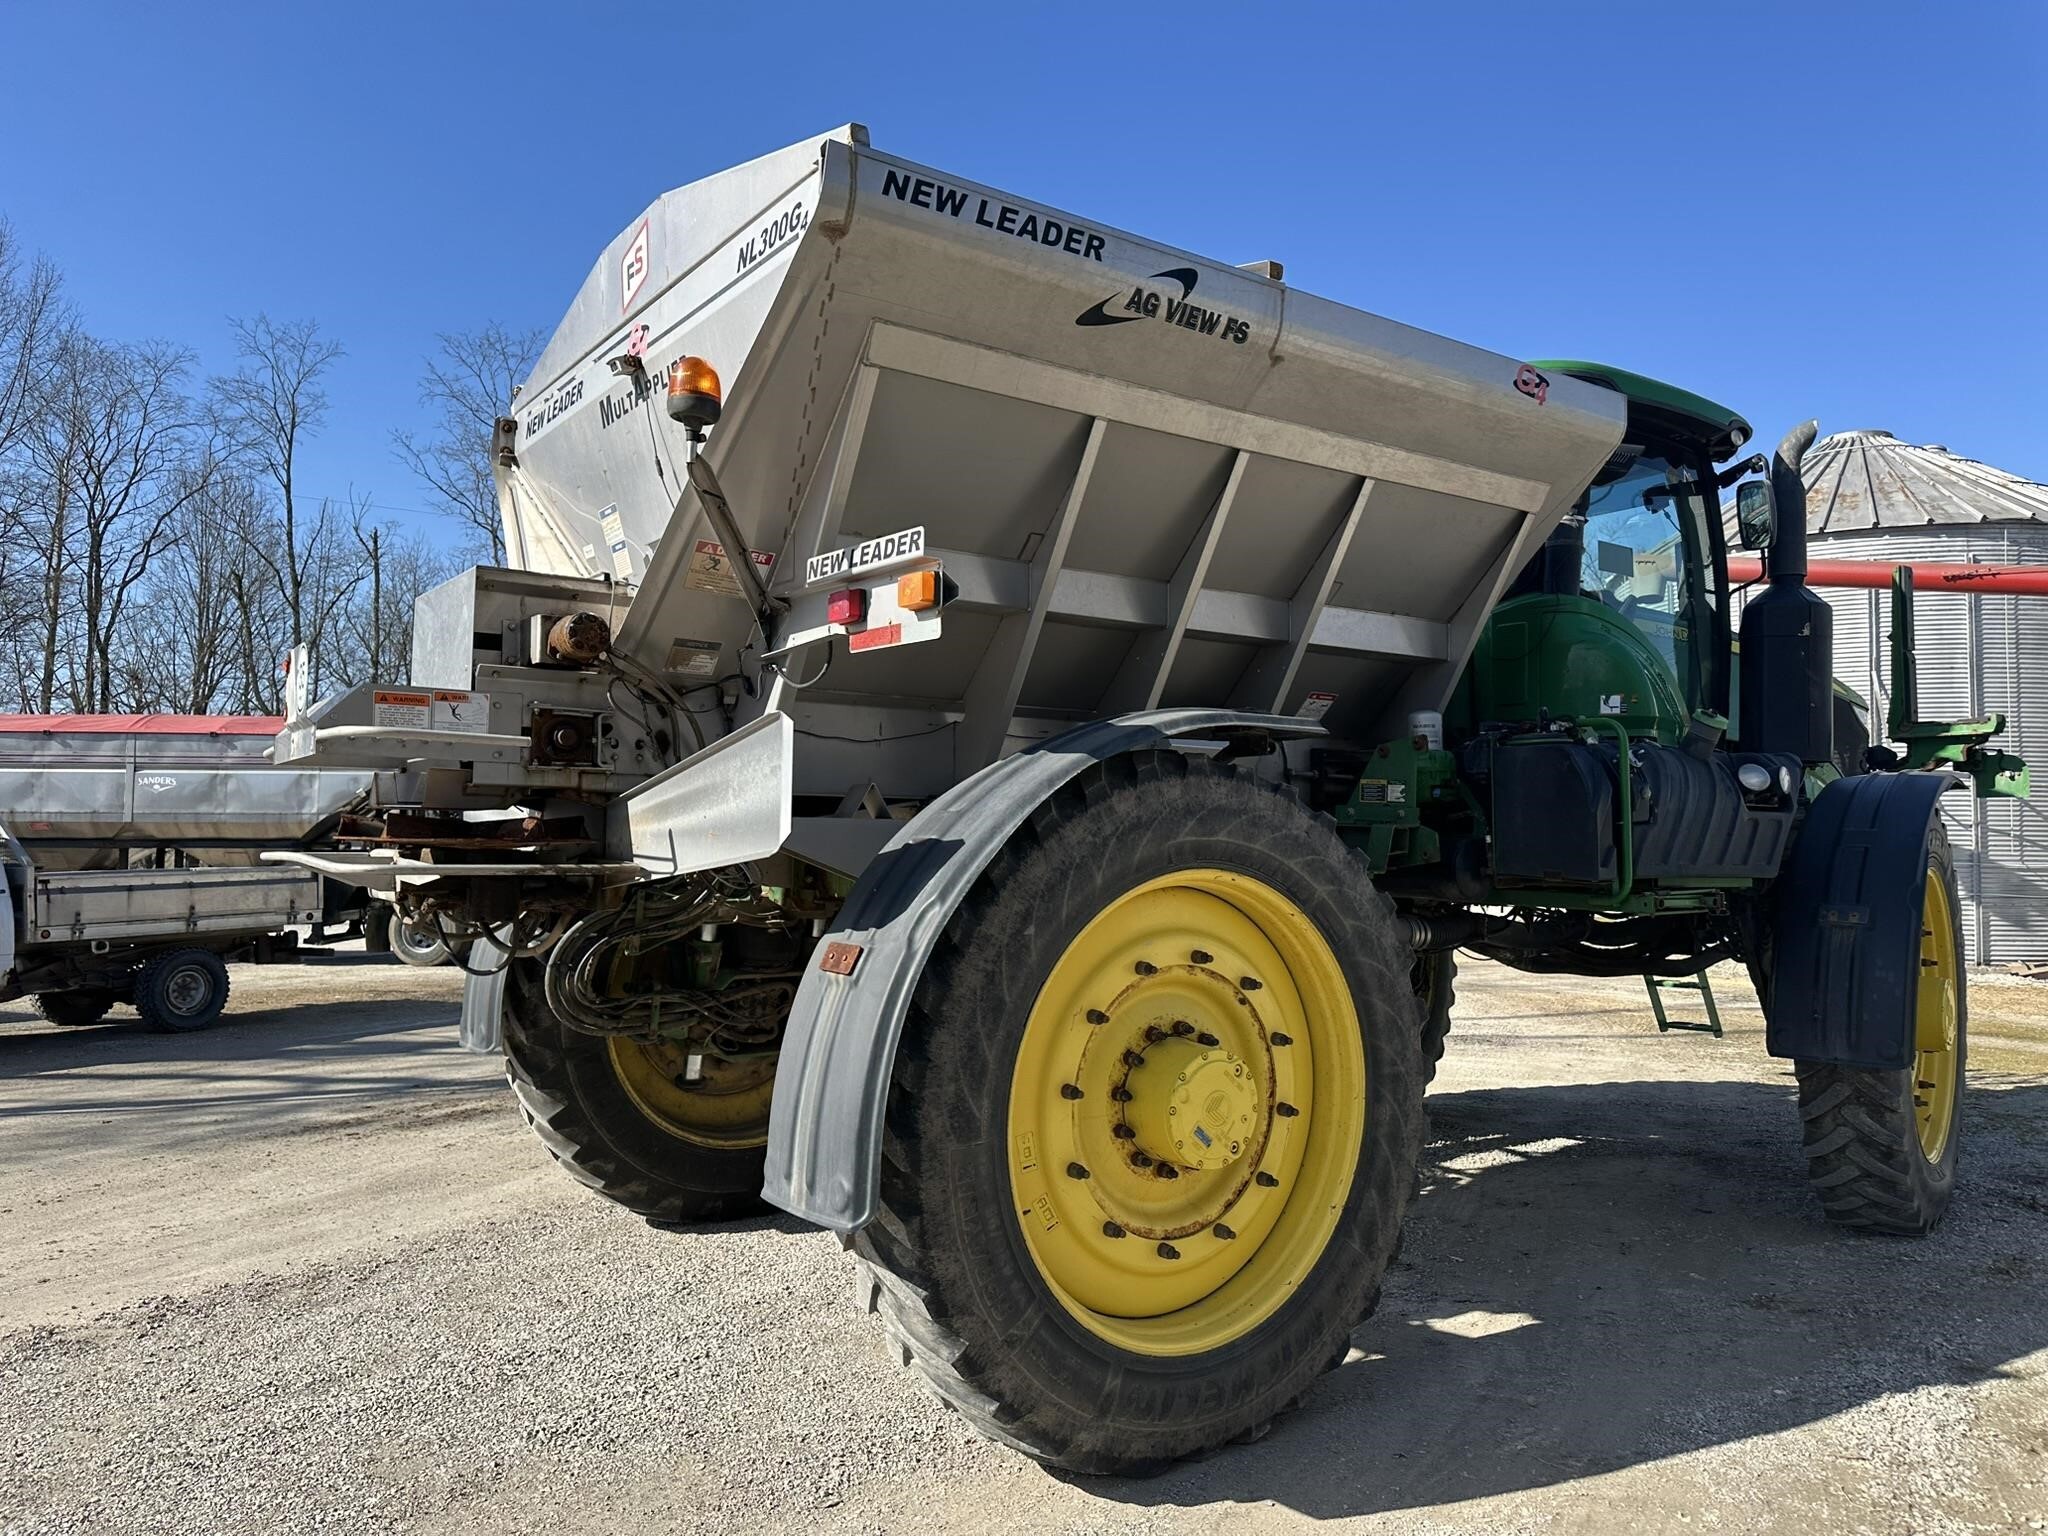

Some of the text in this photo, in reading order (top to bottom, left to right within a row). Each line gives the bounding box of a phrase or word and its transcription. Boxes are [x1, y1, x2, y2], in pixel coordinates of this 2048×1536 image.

[882, 169, 1105, 261] NEW LEADER
[627, 245, 643, 291] FS
[1124, 287, 1251, 344] AG VIEW FS
[526, 380, 583, 440] NEW LEADER
[808, 530, 922, 580] NEW LEADER
[392, 695, 426, 704] WARNING
[138, 776, 177, 786] SANDERS
